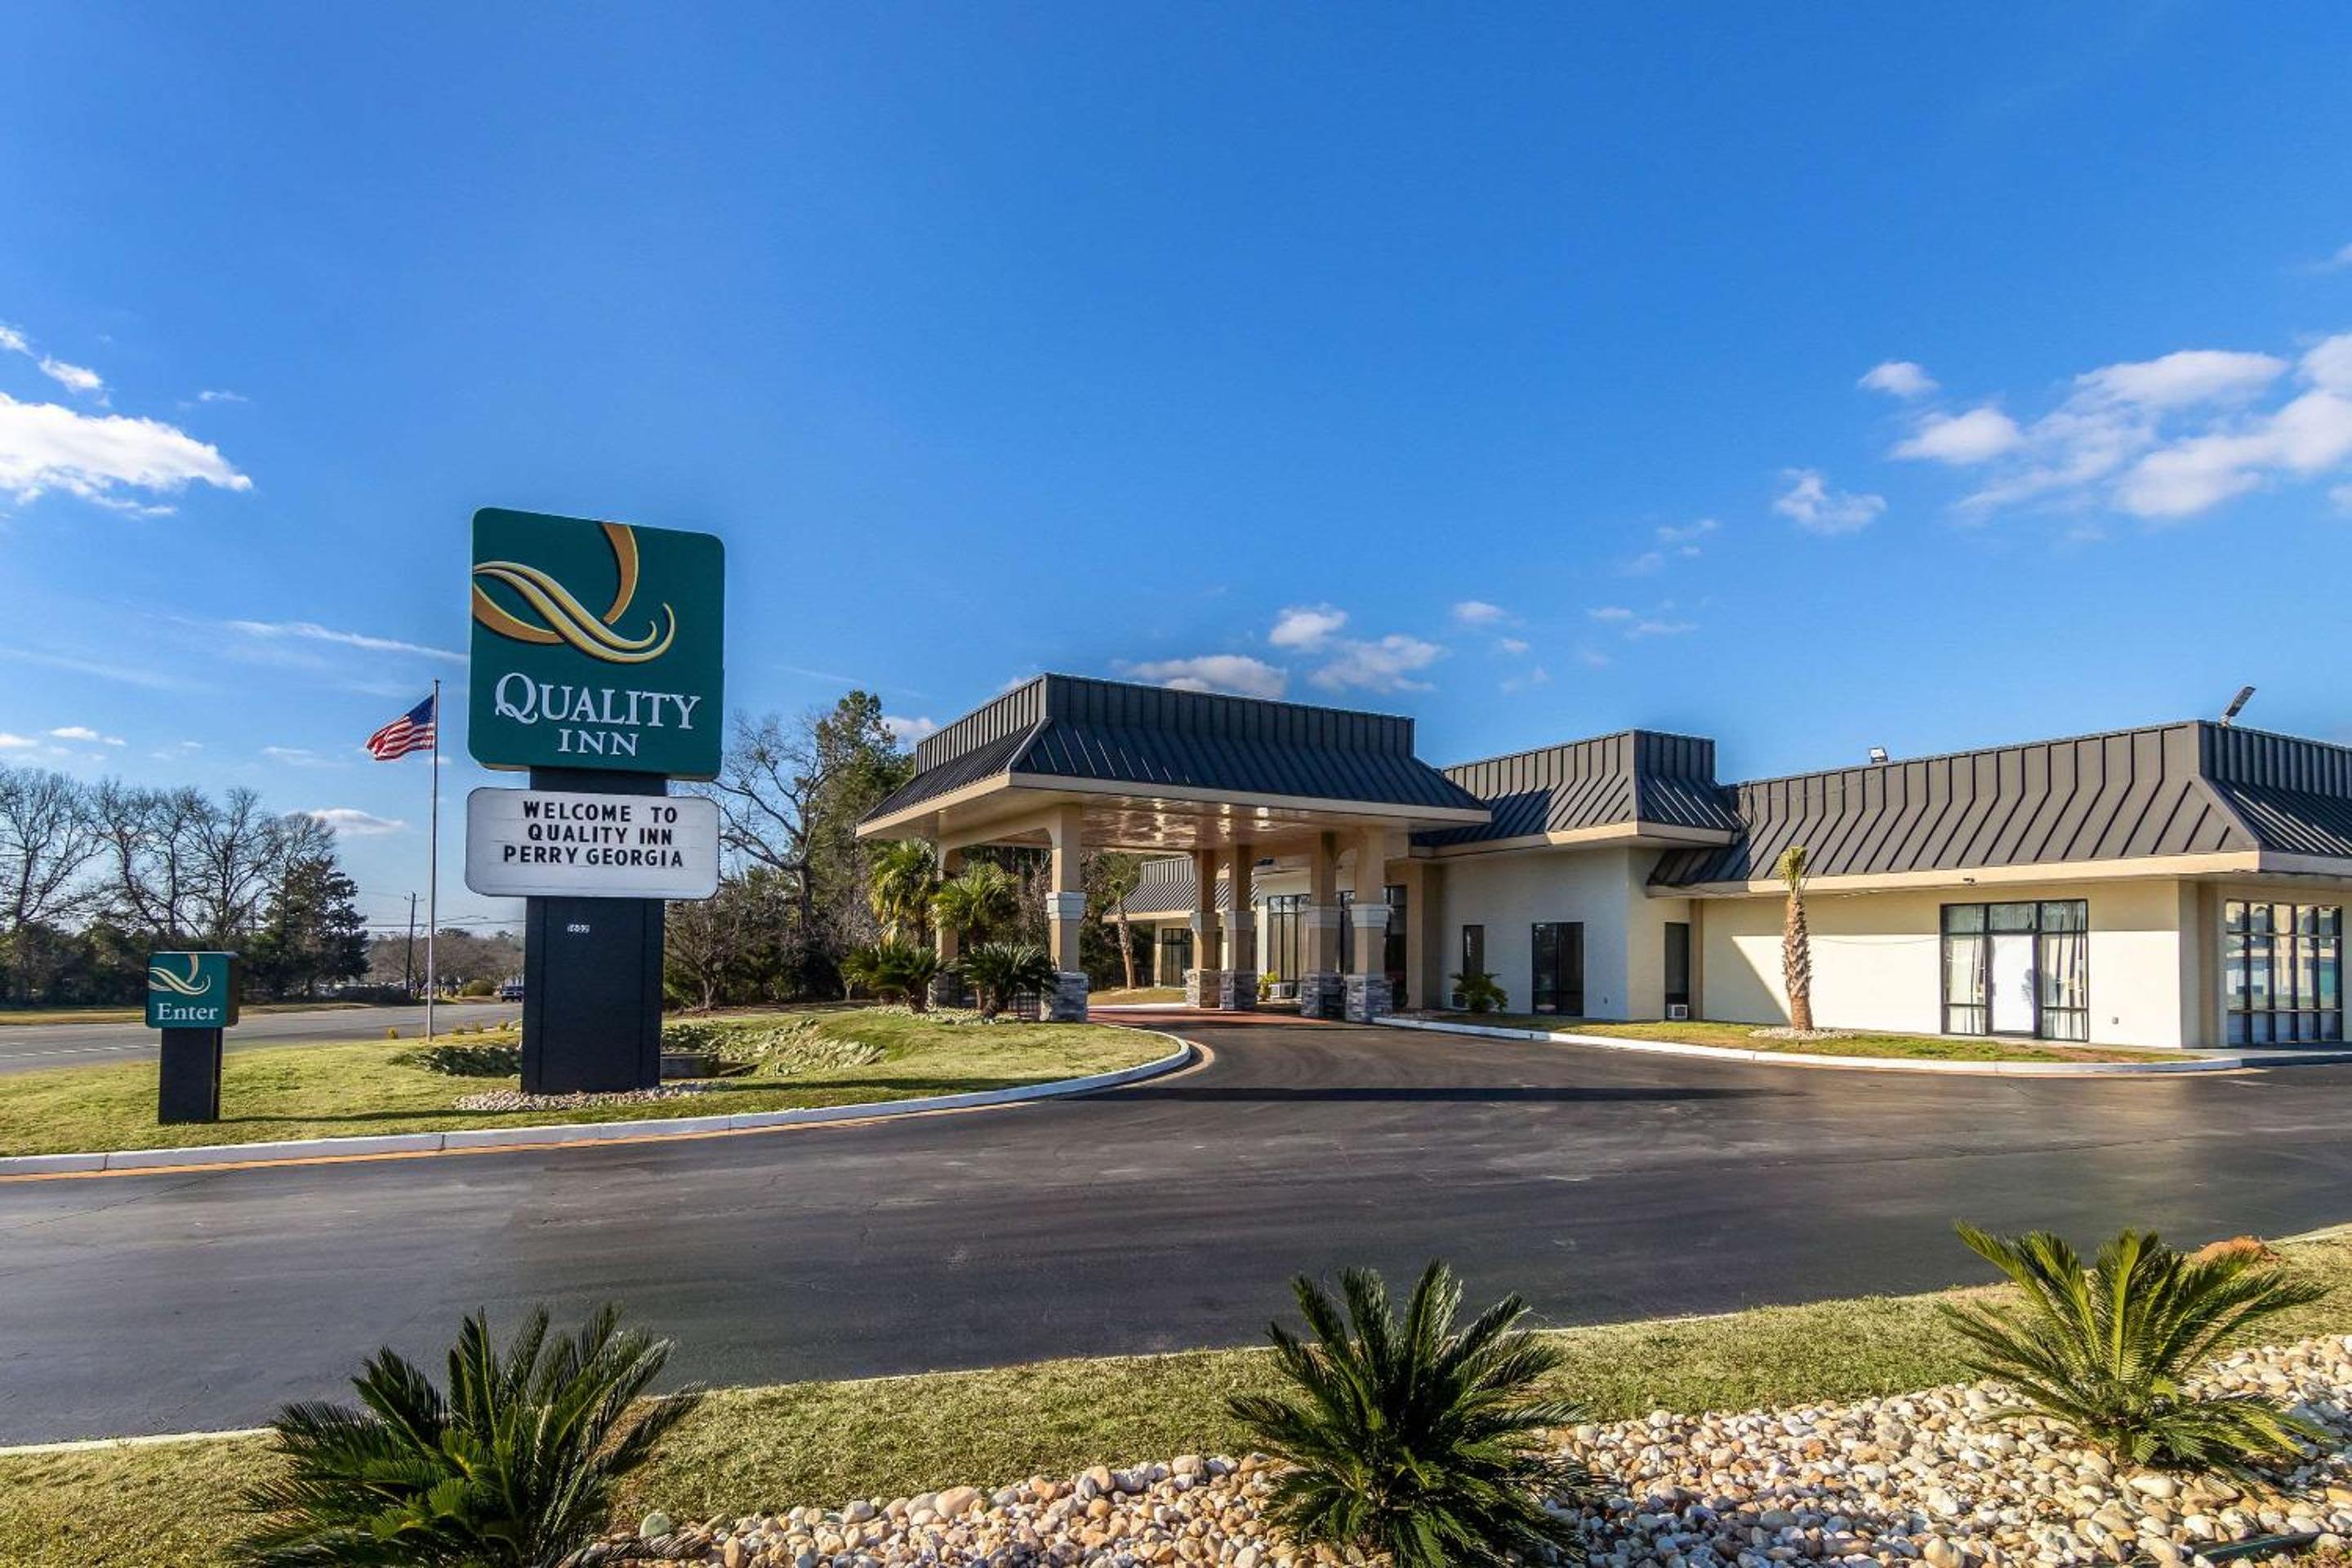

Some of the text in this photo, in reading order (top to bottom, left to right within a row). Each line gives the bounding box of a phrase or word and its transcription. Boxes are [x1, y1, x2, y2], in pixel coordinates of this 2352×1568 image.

[495, 672, 702, 729] QUALITY
[558, 728, 639, 756] INN
[523, 801, 678, 824] WELCOME TO
[528, 824, 673, 845] QUALITY INN
[504, 845, 684, 867] PERRY GEORGIA
[157, 1003, 219, 1020] Enter
